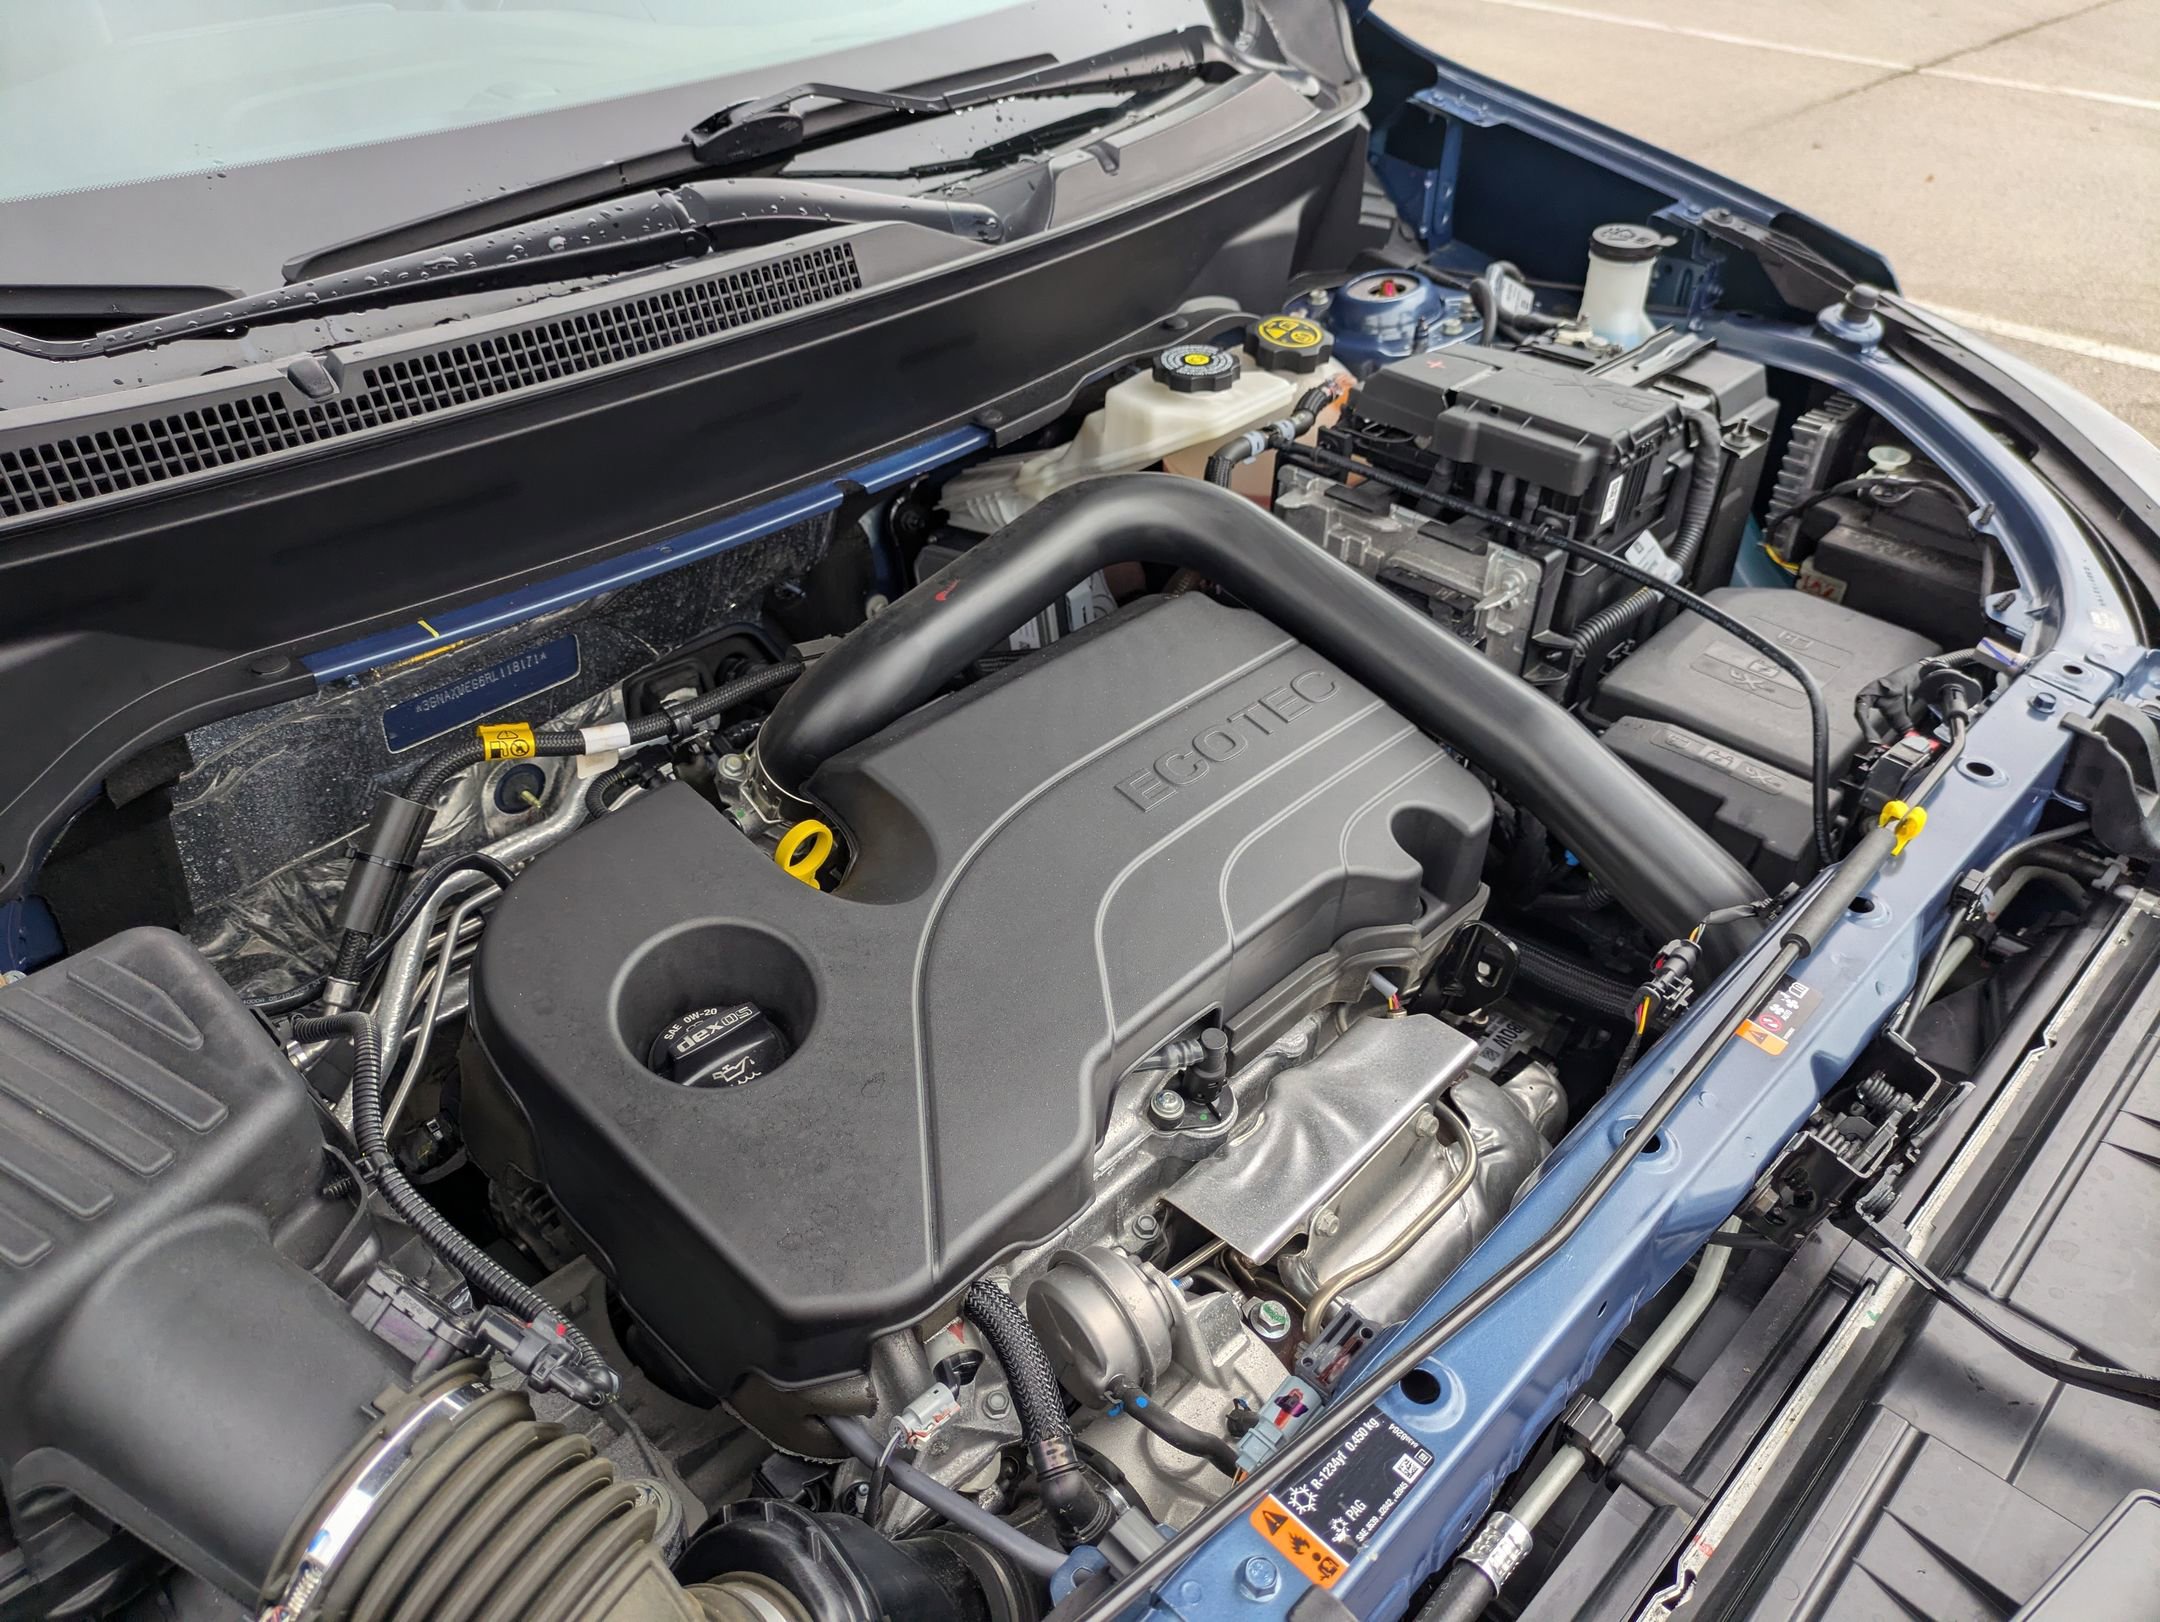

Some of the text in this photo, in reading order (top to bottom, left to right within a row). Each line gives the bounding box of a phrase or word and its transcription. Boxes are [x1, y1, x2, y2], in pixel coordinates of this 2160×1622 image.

[1113, 670, 1342, 813] ECOTEC
[664, 1008, 718, 1041] SAE 0W-20
[1310, 1417, 1380, 1491] R-1234yf 0.450 kg
[1344, 1498, 1367, 1522] PAG
[1355, 1528, 1369, 1543] SAE
